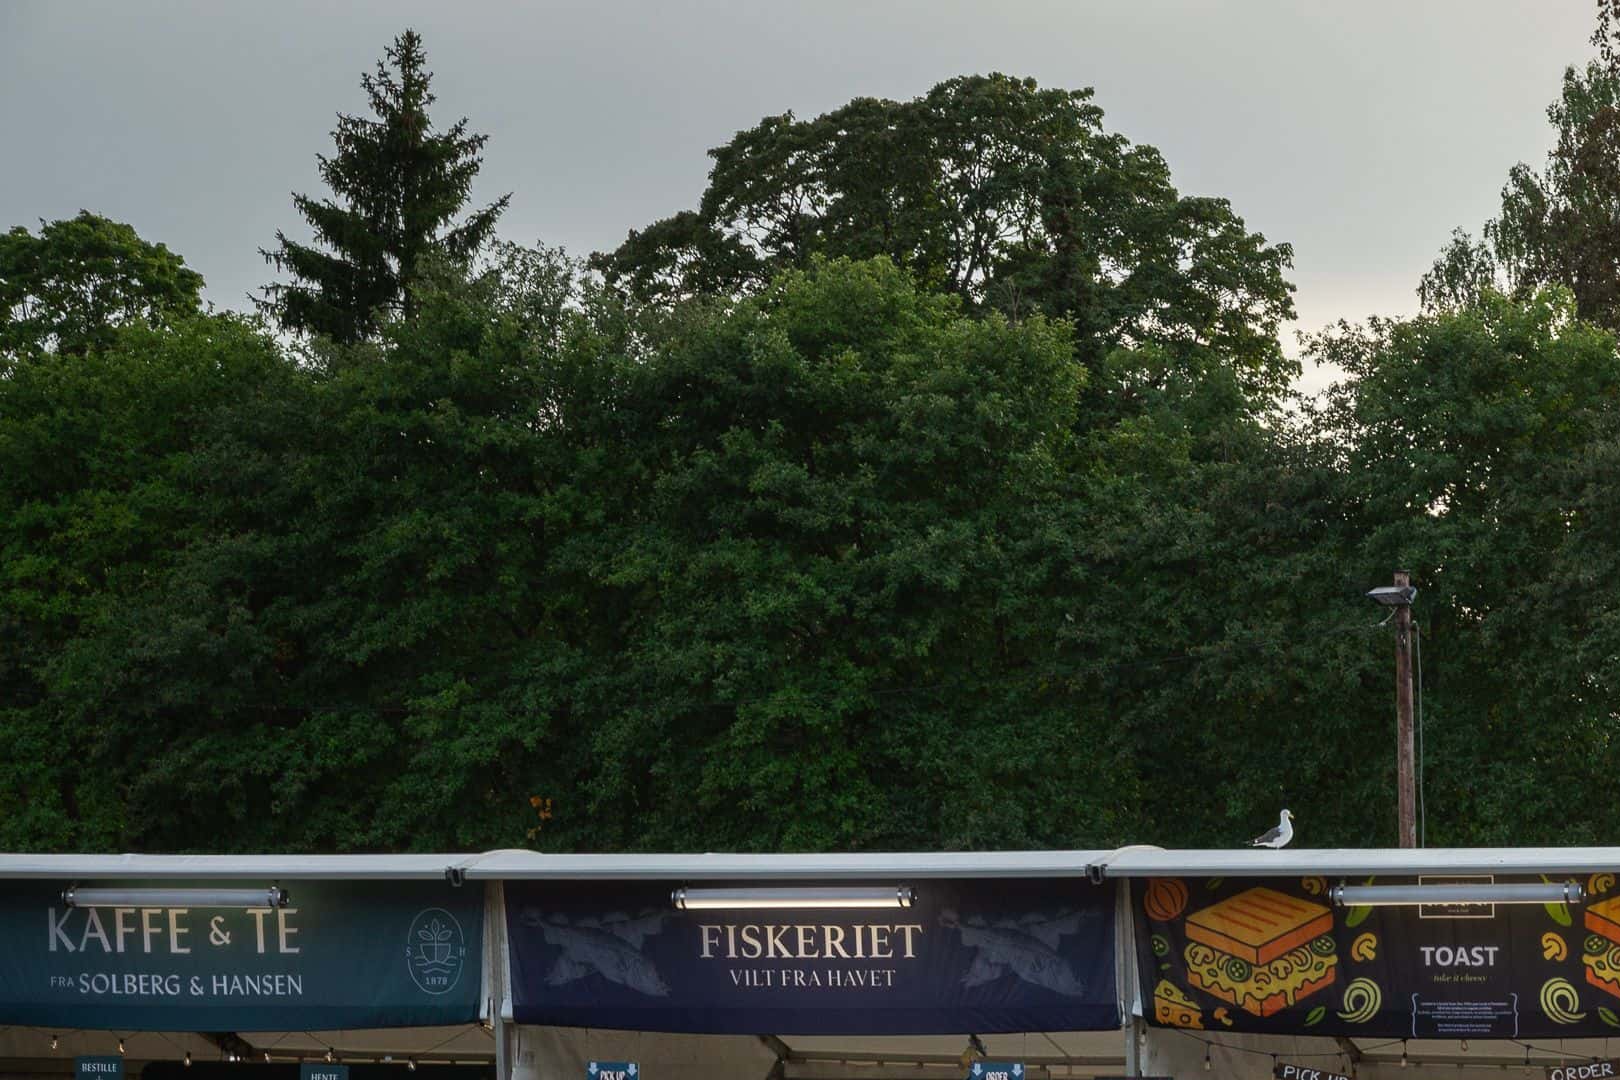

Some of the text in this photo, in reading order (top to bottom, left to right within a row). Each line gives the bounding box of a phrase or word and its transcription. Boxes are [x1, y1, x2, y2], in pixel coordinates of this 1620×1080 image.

[48, 907, 300, 953] KAFFE & TE
[699, 924, 922, 959] FISKERIET
[1420, 947, 1499, 967] TOAST
[51, 973, 303, 995] FRA SOLBERG & HANSEN
[730, 969, 896, 986] VILT FRA HAVET
[81, 1063, 117, 1073] BESTILLE
[600, 1071, 626, 1080] PICK UP
